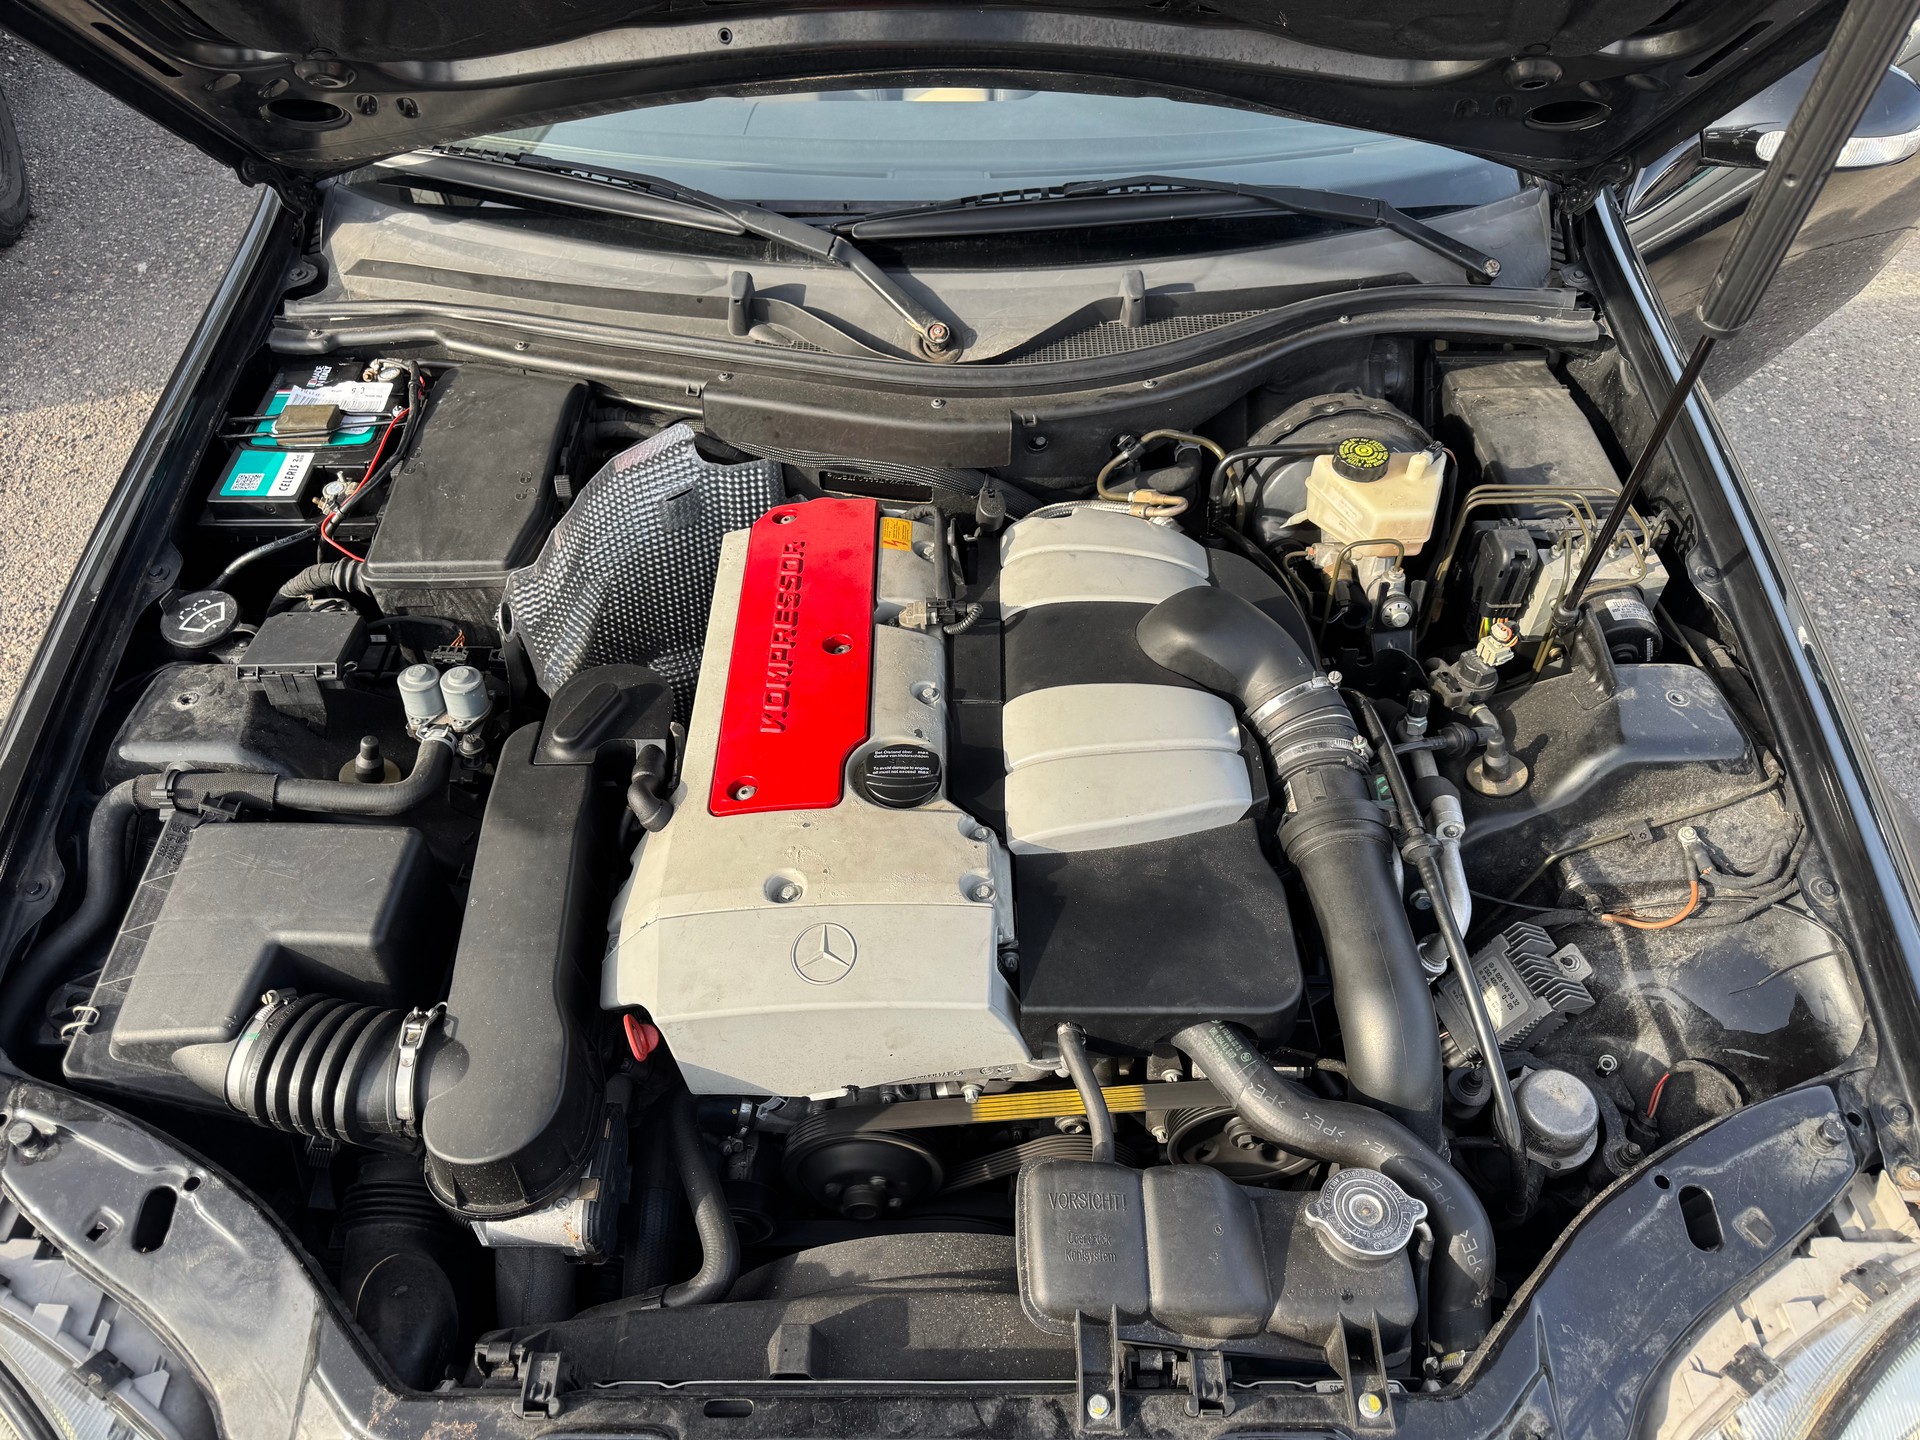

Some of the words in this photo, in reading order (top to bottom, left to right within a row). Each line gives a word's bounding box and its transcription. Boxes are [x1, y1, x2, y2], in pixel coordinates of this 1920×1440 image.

[279, 465, 300, 491] CELERIS
[760, 541, 806, 733] KOMPRESSOR
[1495, 972, 1504, 983] 025
[1507, 991, 1515, 1000] 33
[1512, 999, 1520, 1007] 32
[1049, 1192, 1127, 1211] VORSICHT!
